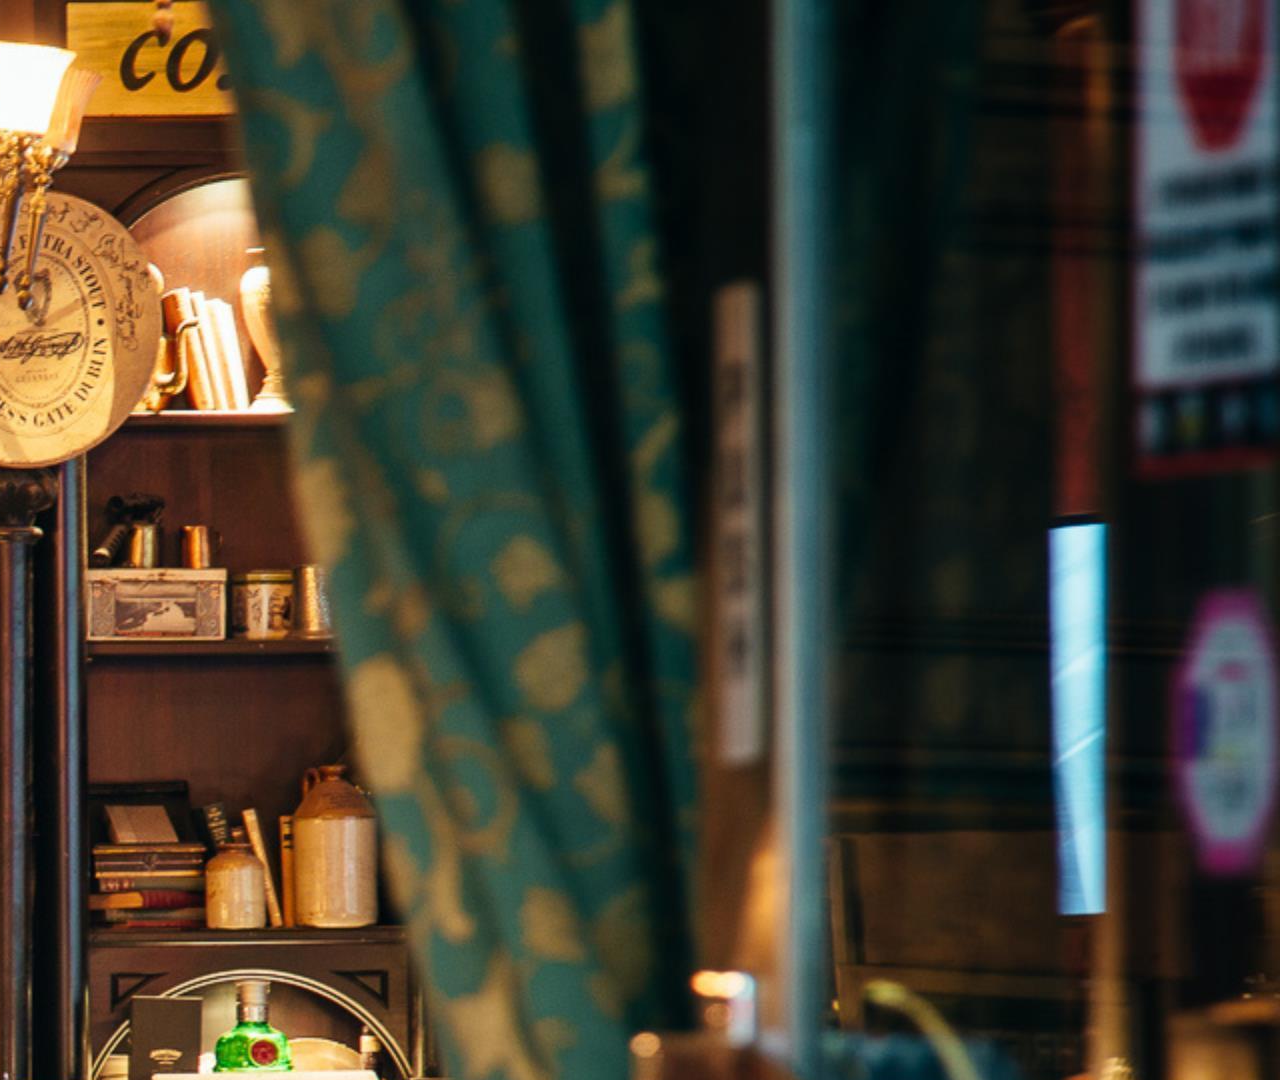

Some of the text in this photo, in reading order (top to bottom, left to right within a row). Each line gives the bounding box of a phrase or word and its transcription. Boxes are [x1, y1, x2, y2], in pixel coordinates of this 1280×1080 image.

[120, 28, 233, 92] CO
[19, 233, 73, 259] ETRA
[73, 254, 107, 310] STOUT
